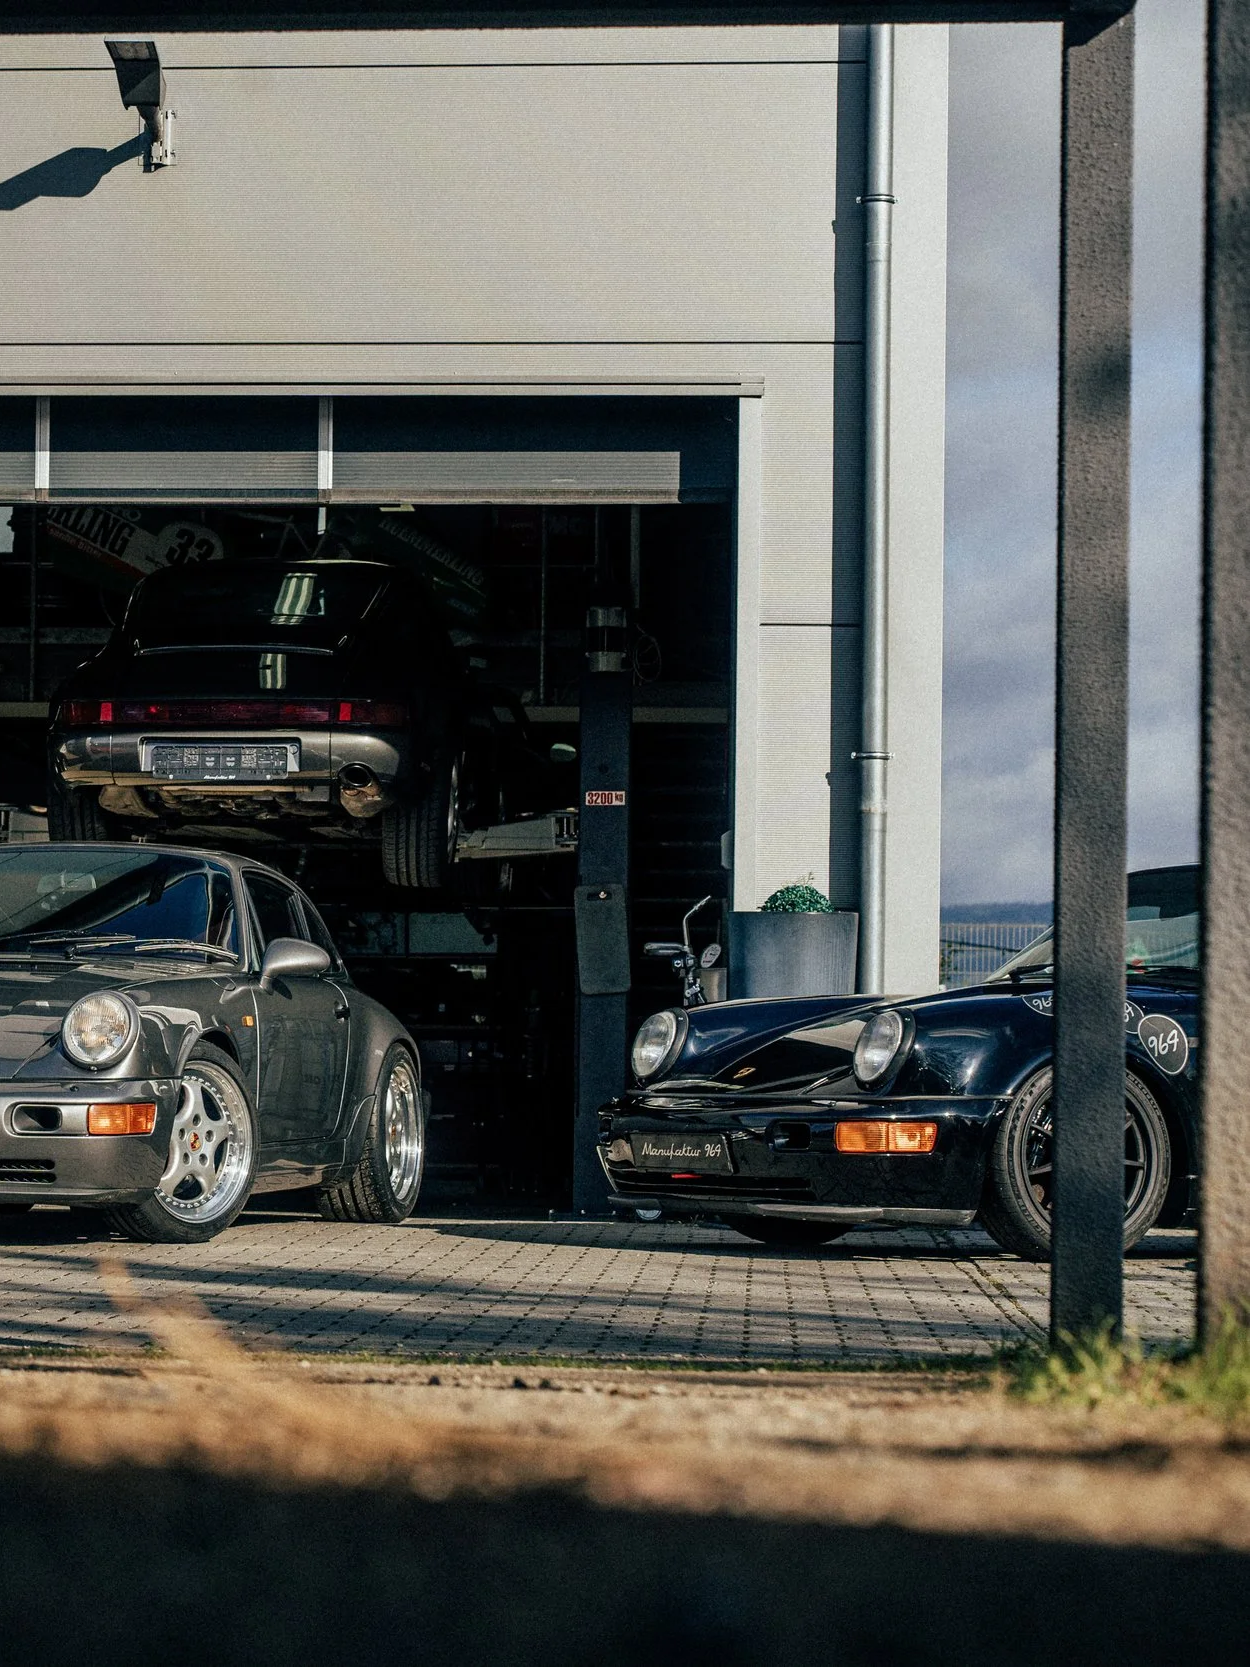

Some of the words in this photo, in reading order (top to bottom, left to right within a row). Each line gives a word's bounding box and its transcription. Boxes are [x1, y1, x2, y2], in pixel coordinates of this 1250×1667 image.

[165, 528, 216, 567] 33
[588, 792, 613, 805] 3200
[1148, 1029, 1180, 1057] 964
[642, 1142, 702, 1160] Manufaktur
[704, 1143, 722, 1157] 964
